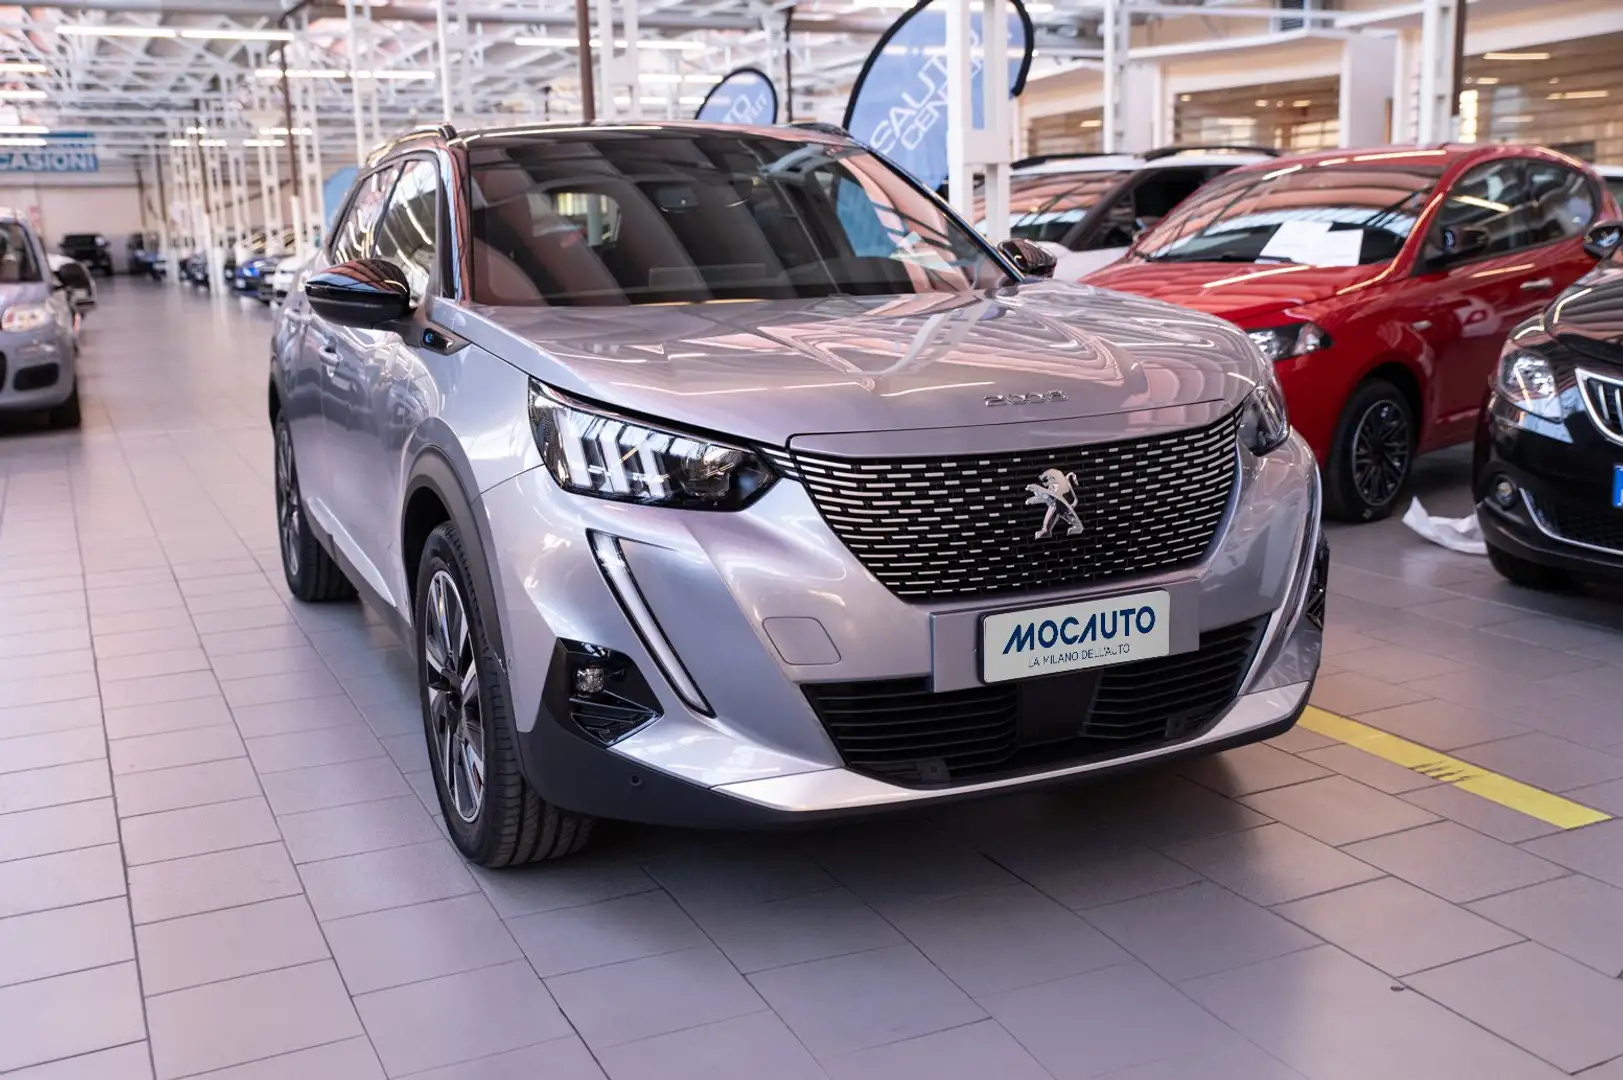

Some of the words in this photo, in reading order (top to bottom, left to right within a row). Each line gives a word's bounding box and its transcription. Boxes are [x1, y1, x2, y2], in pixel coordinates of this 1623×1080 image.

[1003, 606, 1156, 655] MOCAUTO
[1029, 657, 1040, 668] LA
[1043, 651, 1079, 665] MILANO
